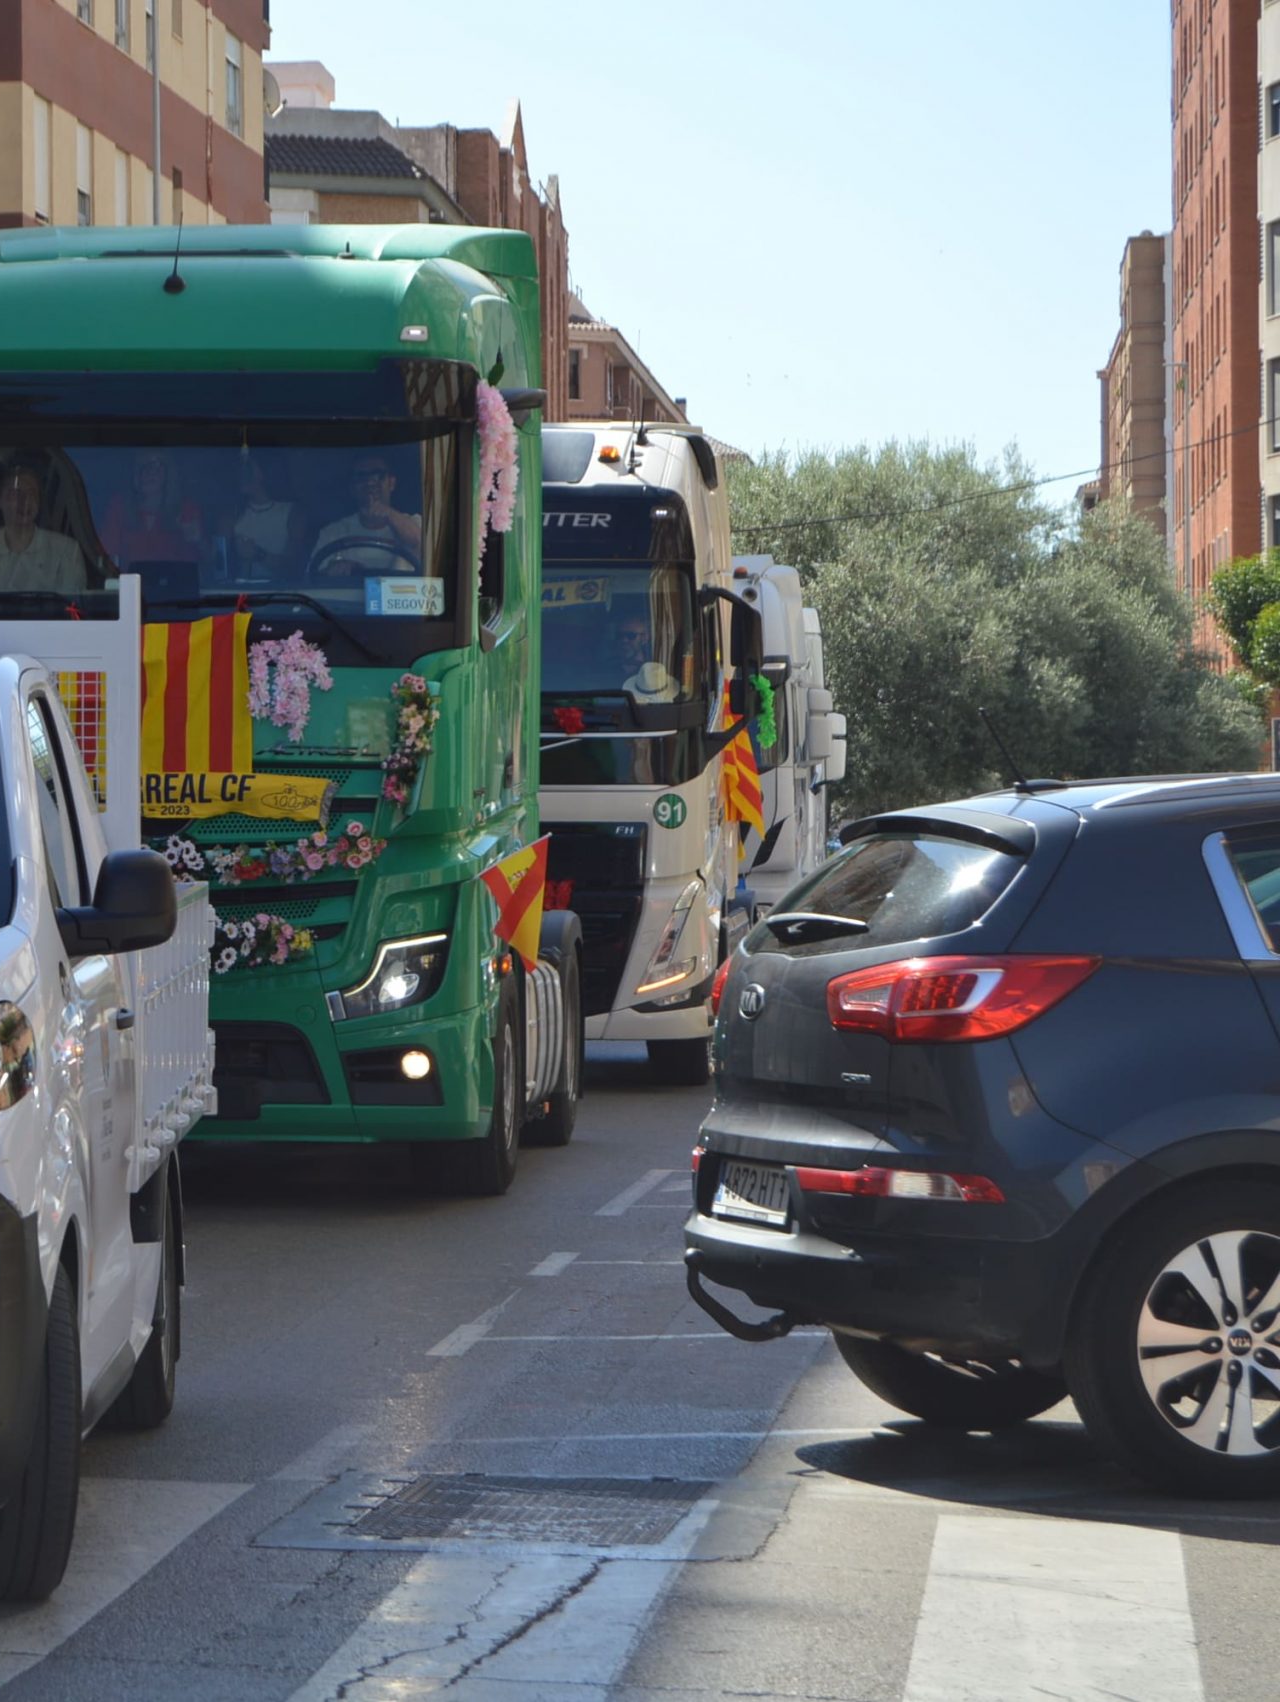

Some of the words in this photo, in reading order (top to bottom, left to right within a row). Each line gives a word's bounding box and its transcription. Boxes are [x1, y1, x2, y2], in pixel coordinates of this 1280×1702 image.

[541, 512, 612, 527] TTER
[387, 598, 438, 610] SEGOVIA
[220, 774, 256, 802] CF
[160, 805, 190, 816] 2023
[658, 801, 682, 822] 91
[616, 826, 634, 834] FH
